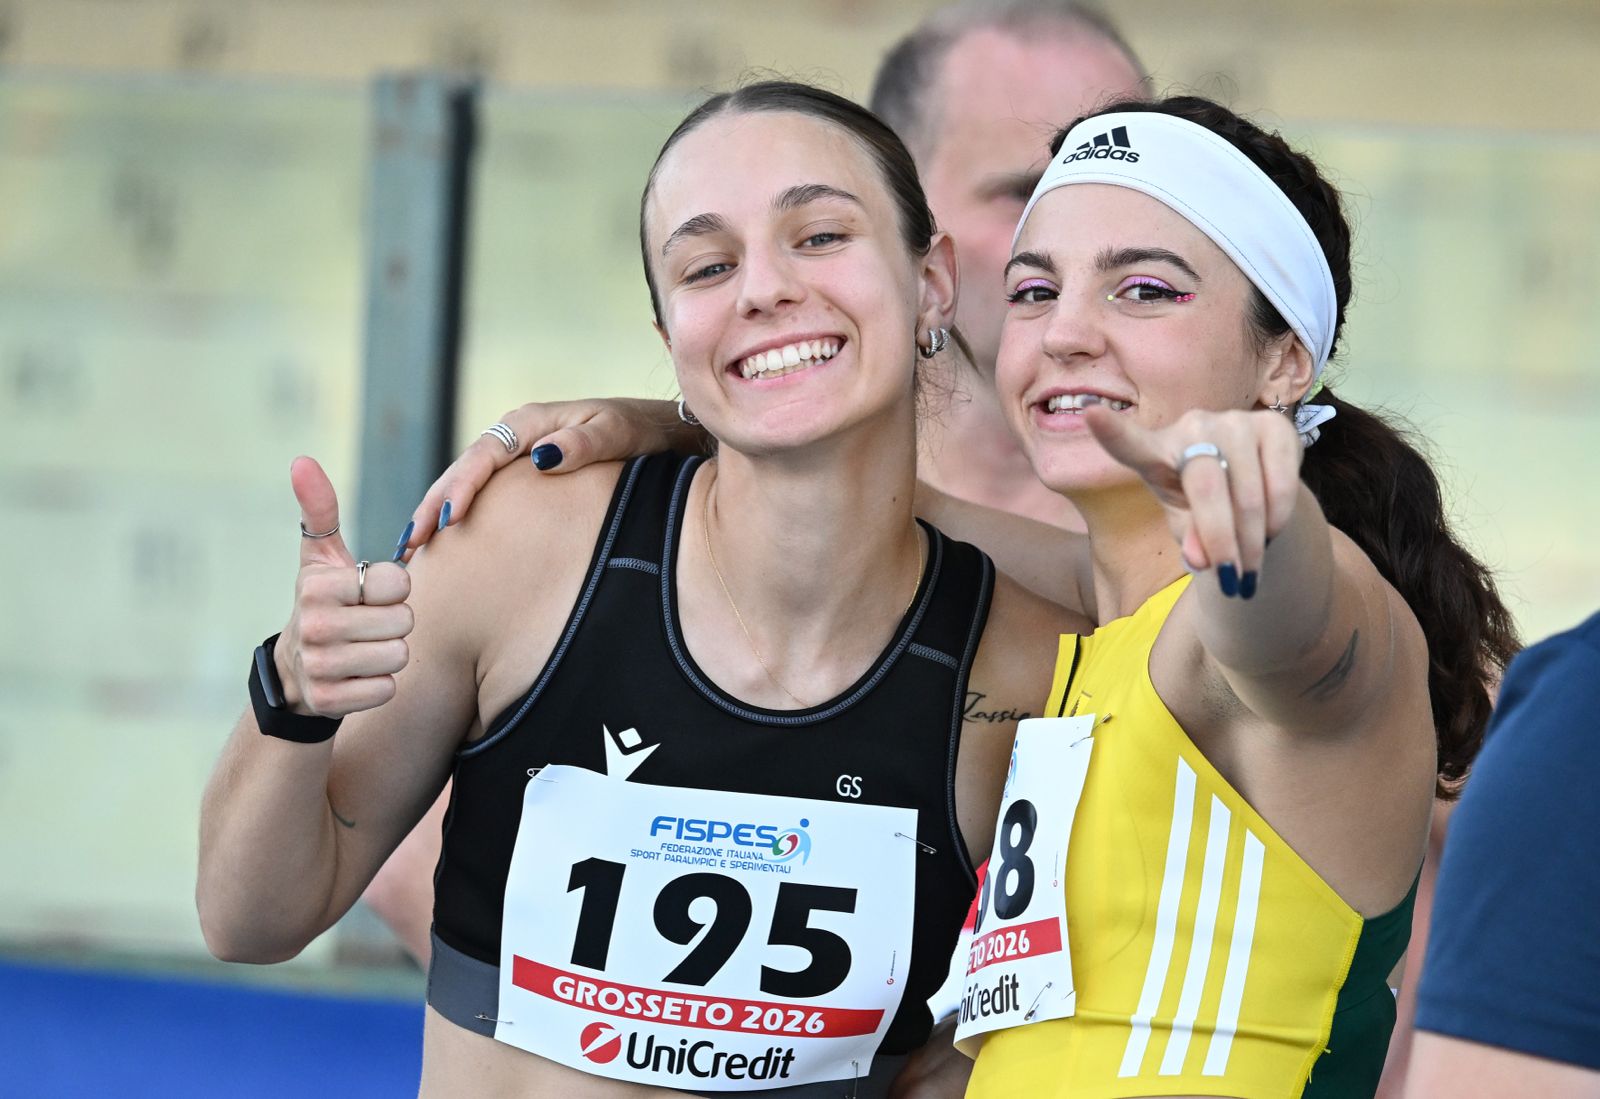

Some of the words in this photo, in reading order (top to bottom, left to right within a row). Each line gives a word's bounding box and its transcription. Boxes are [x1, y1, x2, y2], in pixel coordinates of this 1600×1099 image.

[1063, 146, 1140, 164] adidas
[836, 774, 863, 799] GS
[650, 815, 778, 848] FISPES
[630, 849, 661, 861] SPORT
[664, 854, 717, 867] PARALIMPICI
[720, 859, 726, 868] E
[730, 861, 792, 874] SPERIMENTALI
[660, 842, 723, 857] FEDERAZIONE
[726, 849, 764, 861] ITALIANA
[566, 856, 858, 998] 195
[986, 929, 1031, 962] 2026
[552, 975, 734, 1026] GROSSETO
[740, 1005, 826, 1034] 2026
[958, 973, 1020, 1024] niCredit
[625, 1031, 796, 1080] UniCredit
